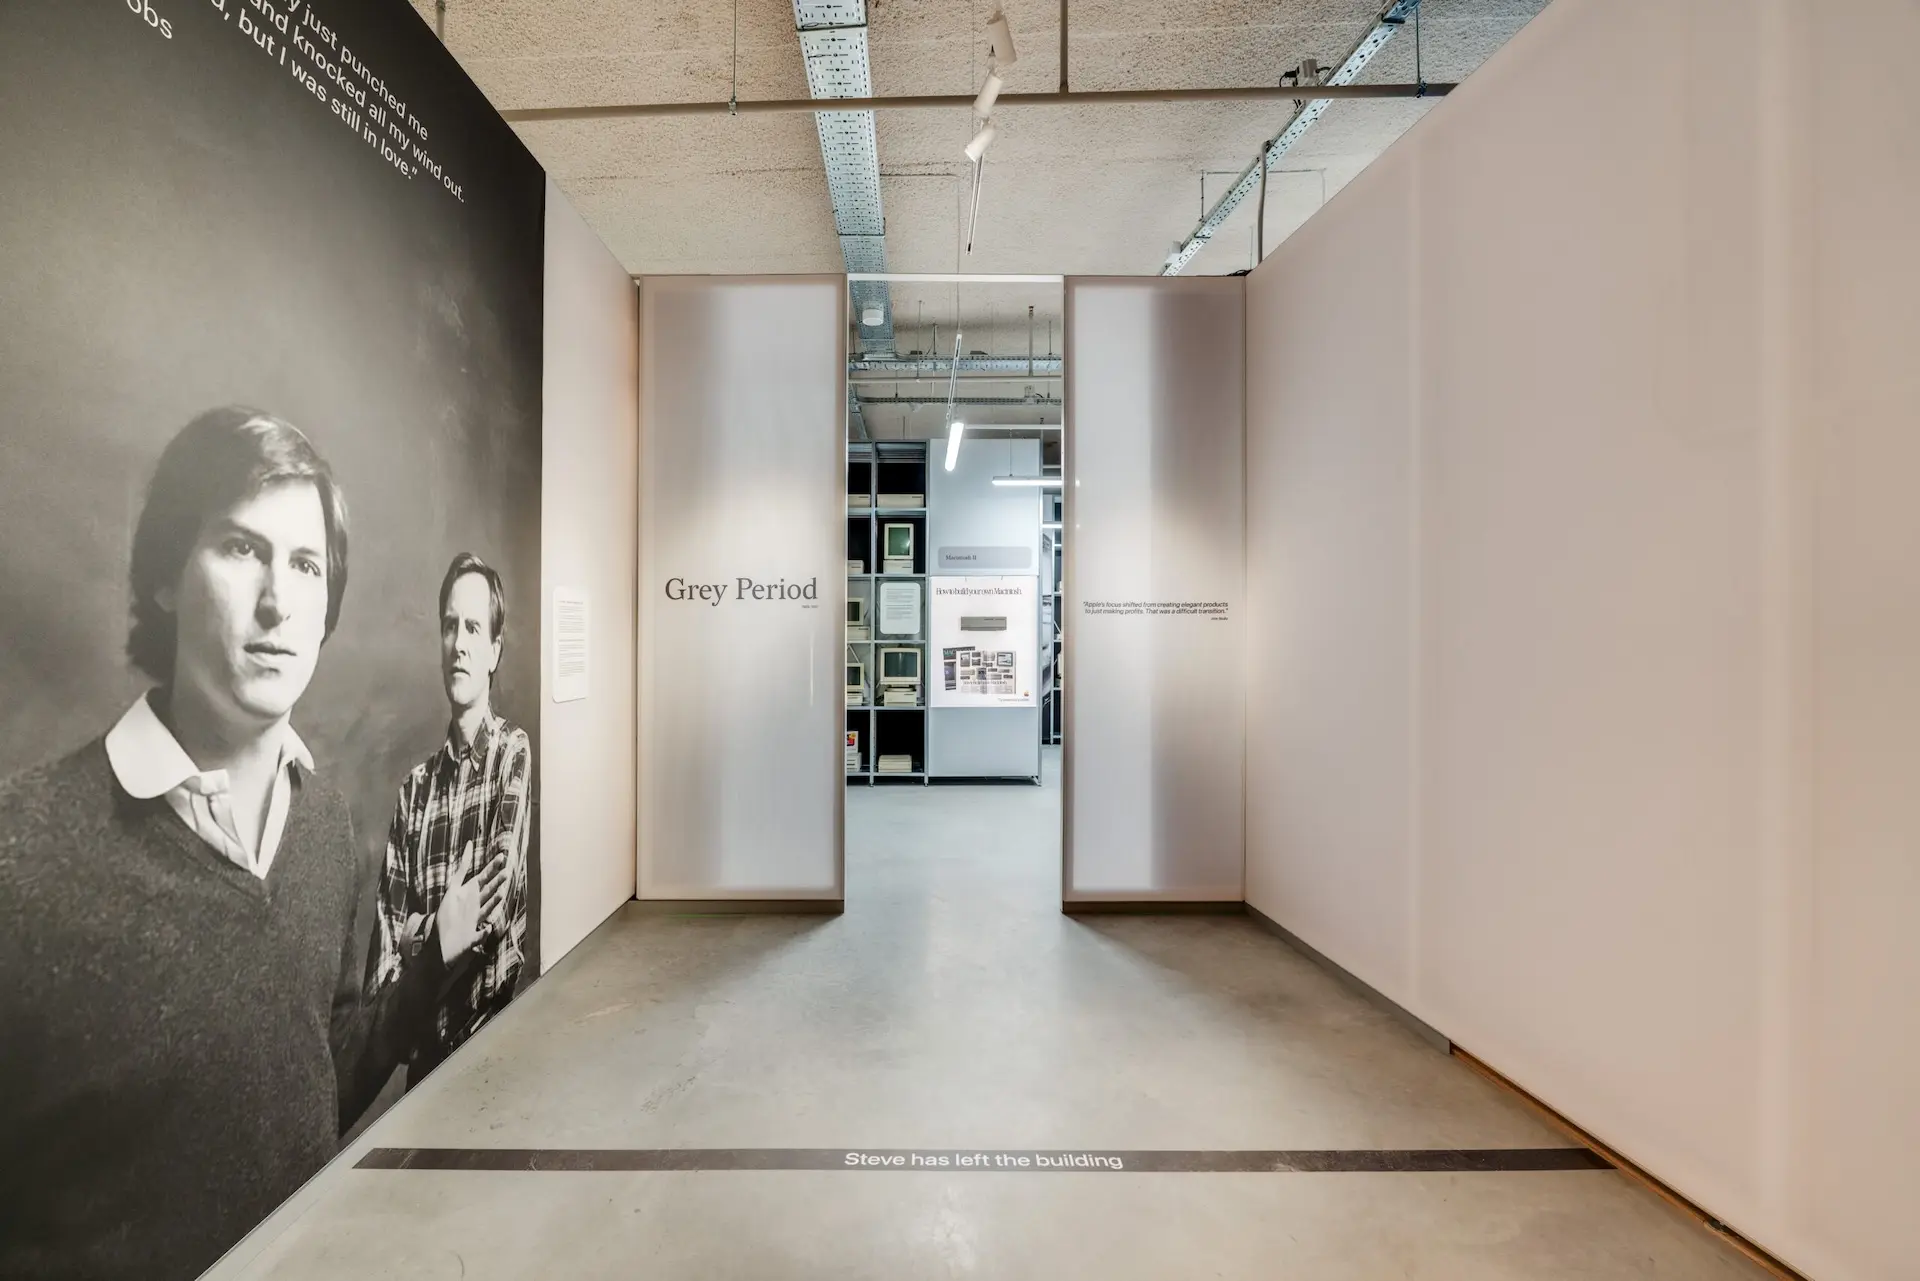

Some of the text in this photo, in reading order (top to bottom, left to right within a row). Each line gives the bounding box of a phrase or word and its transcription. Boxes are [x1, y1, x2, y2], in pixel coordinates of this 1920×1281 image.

[239, 8, 275, 56] but
[280, 46, 286, 65] I
[291, 60, 327, 102] was
[331, 98, 361, 132] still
[363, 122, 377, 148] in
[380, 138, 418, 179] love."
[293, 25, 366, 108] knocked
[369, 103, 387, 127] all
[389, 122, 410, 150] my
[412, 144, 442, 180] wind
[444, 175, 465, 203] out.
[302, 4, 338, 51] just
[340, 45, 406, 119] punched
[408, 113, 428, 140] me
[665, 577, 818, 606] Grey Period
[844, 1152, 1124, 1169] Steve has left the building
